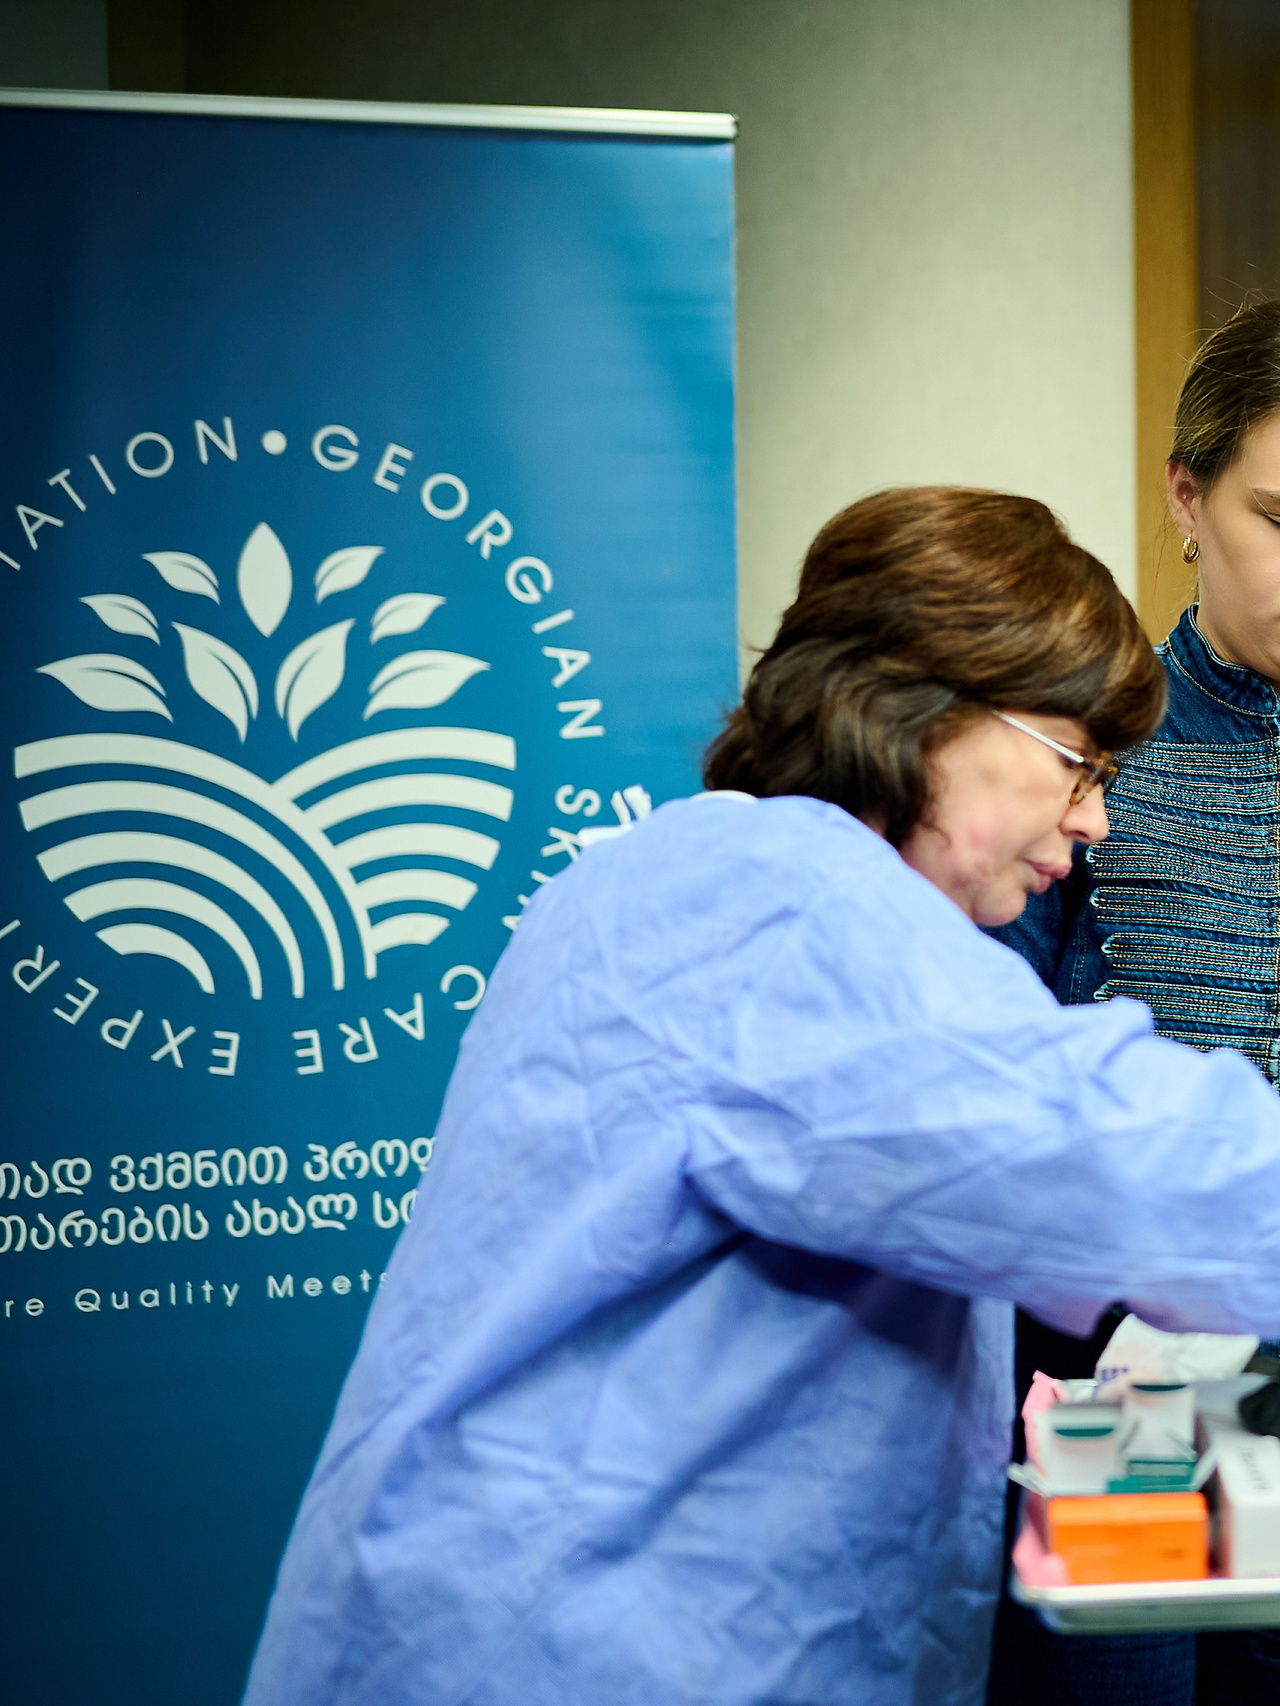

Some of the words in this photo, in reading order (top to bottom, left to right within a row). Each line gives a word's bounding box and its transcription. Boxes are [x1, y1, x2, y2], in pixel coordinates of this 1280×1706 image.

[310, 424, 605, 740] GEORGIAN
[291, 964, 487, 1076] CARE
[109, 1145, 289, 1194] ვქმნით
[225, 1192, 358, 1239] ახალ
[74, 1279, 240, 1314] Quality
